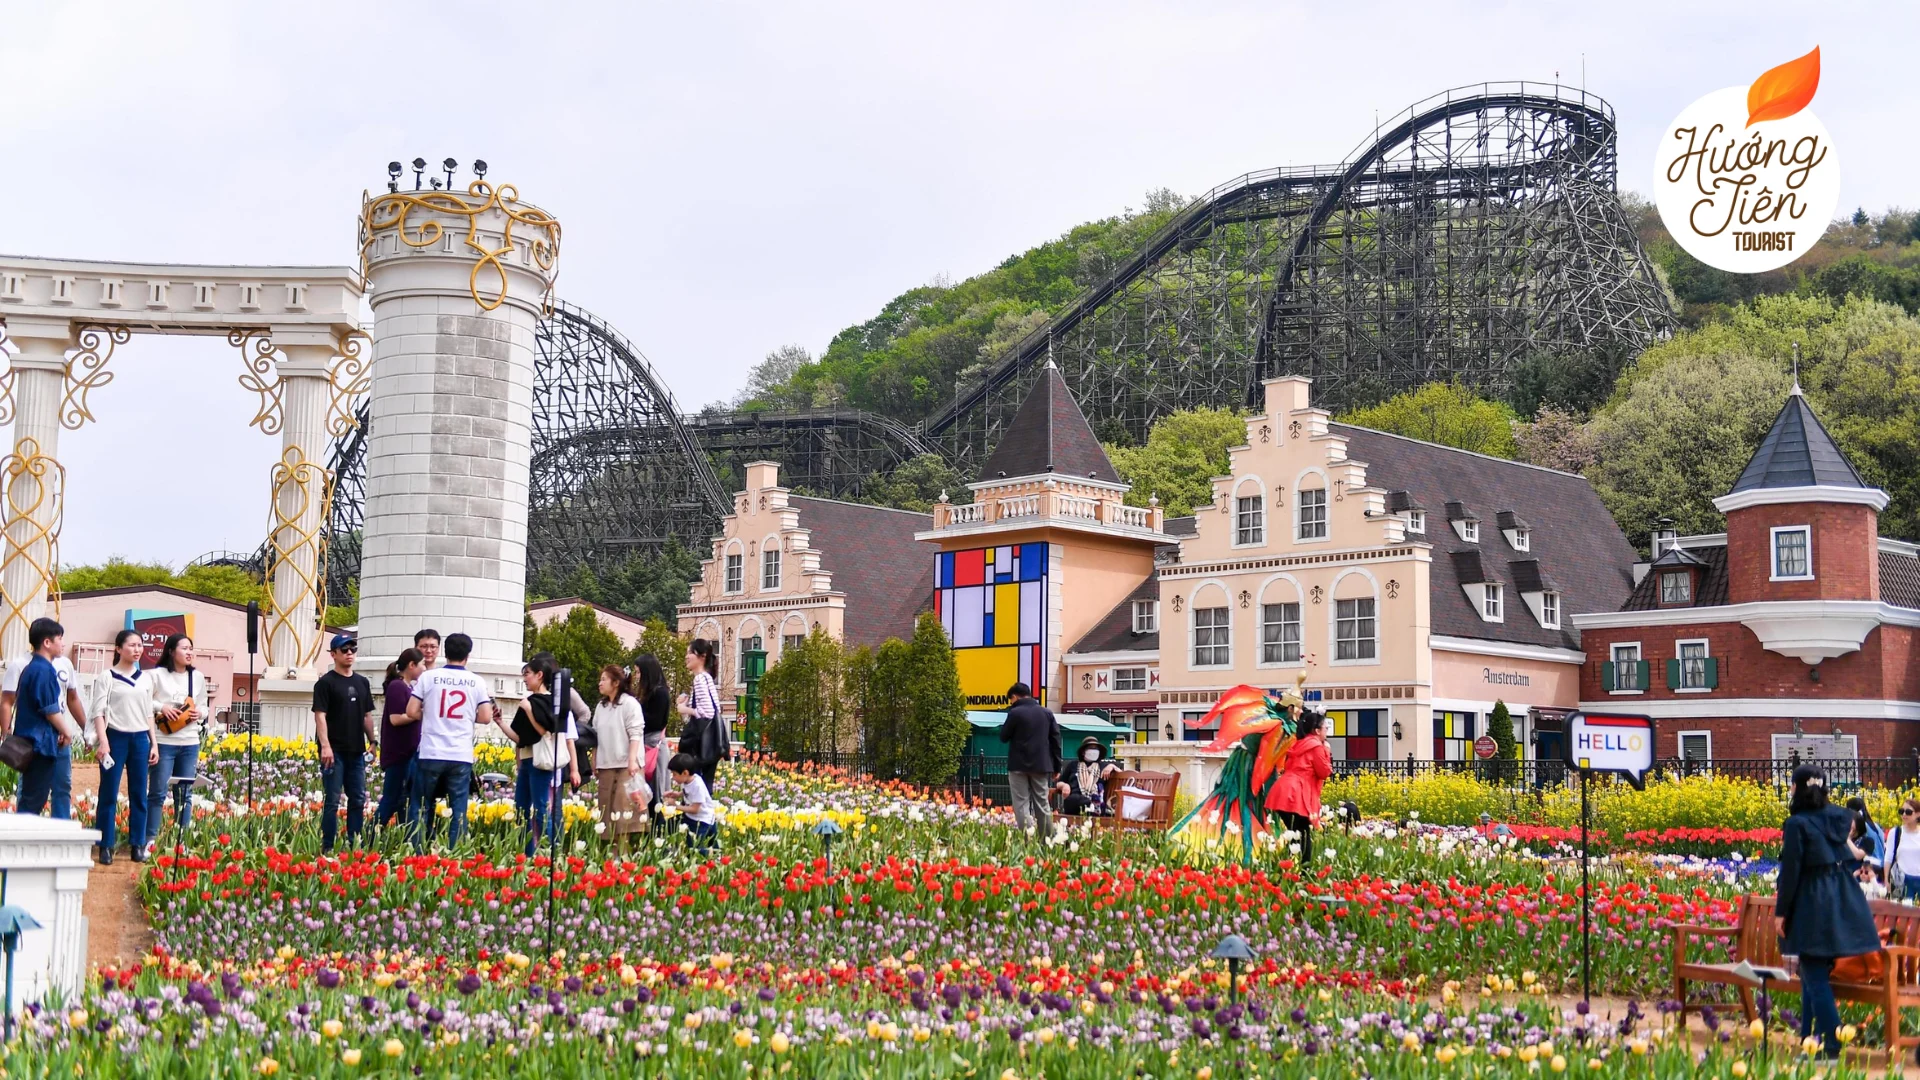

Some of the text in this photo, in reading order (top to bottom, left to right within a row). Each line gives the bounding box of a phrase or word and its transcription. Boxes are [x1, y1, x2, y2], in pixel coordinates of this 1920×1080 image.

[433, 676, 476, 687] ENGLAND
[1482, 667, 1530, 687] Amsterdam
[439, 688, 466, 719] 12
[1578, 733, 1642, 752] HELLO
